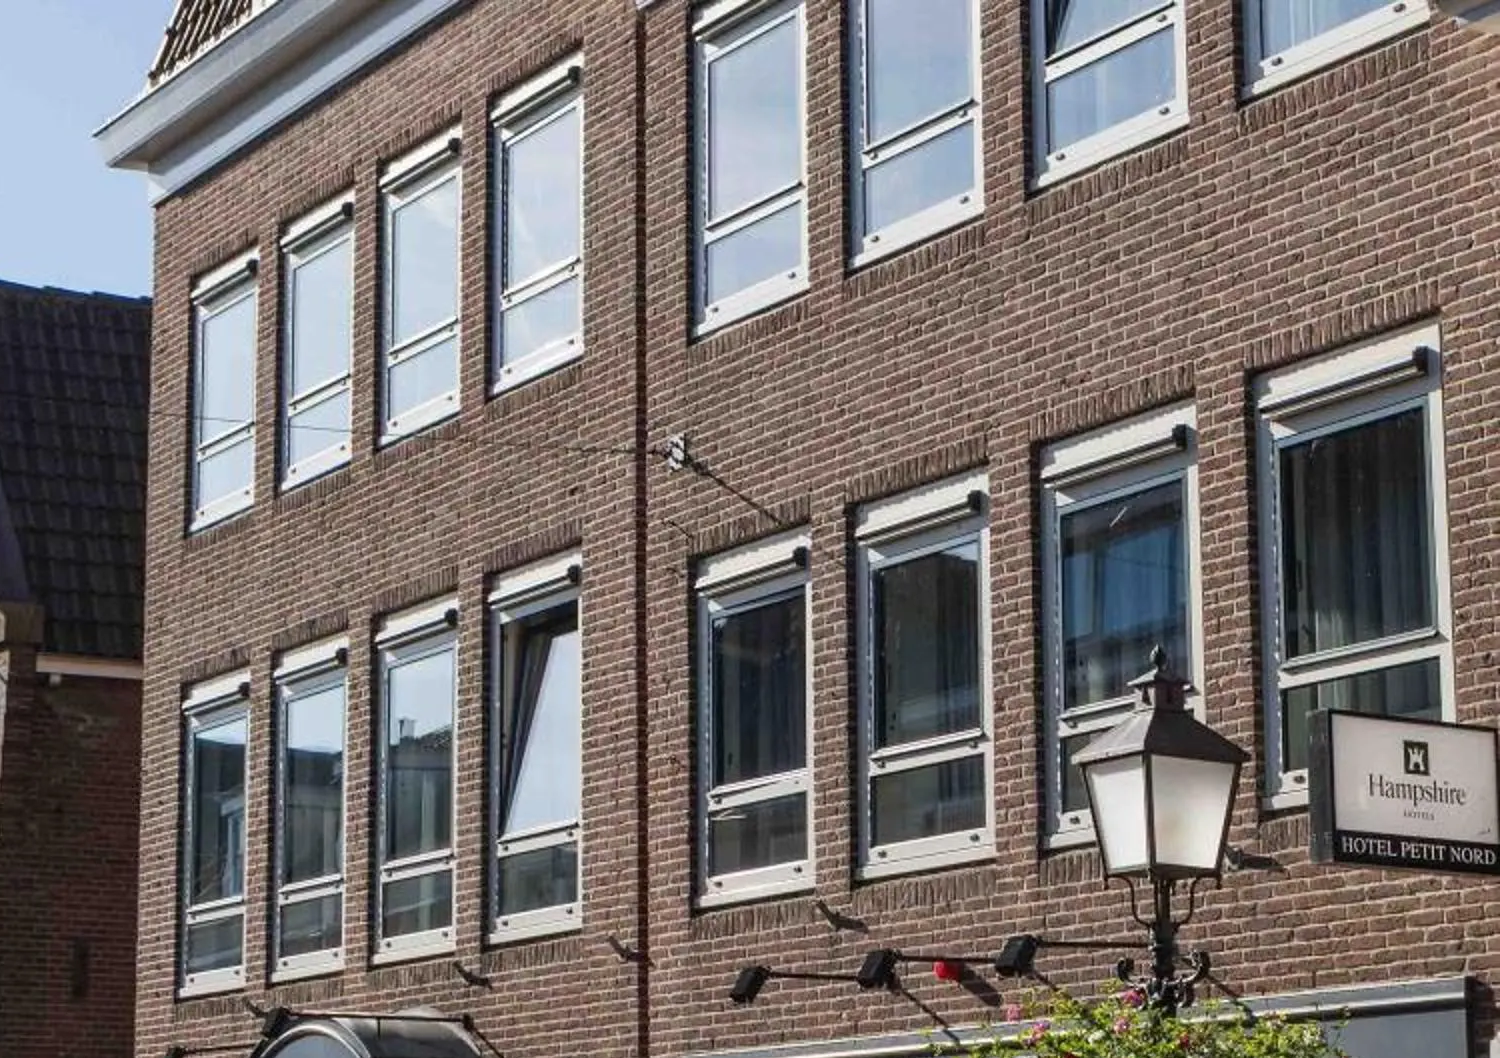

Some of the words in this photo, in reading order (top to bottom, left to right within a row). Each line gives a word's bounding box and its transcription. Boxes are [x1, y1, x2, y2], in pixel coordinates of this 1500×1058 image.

[1368, 773, 1467, 807] Hampshire
[1341, 836, 1398, 858] HOTEL
[1401, 841, 1447, 862] PETIT
[1450, 846, 1497, 866] NORD
